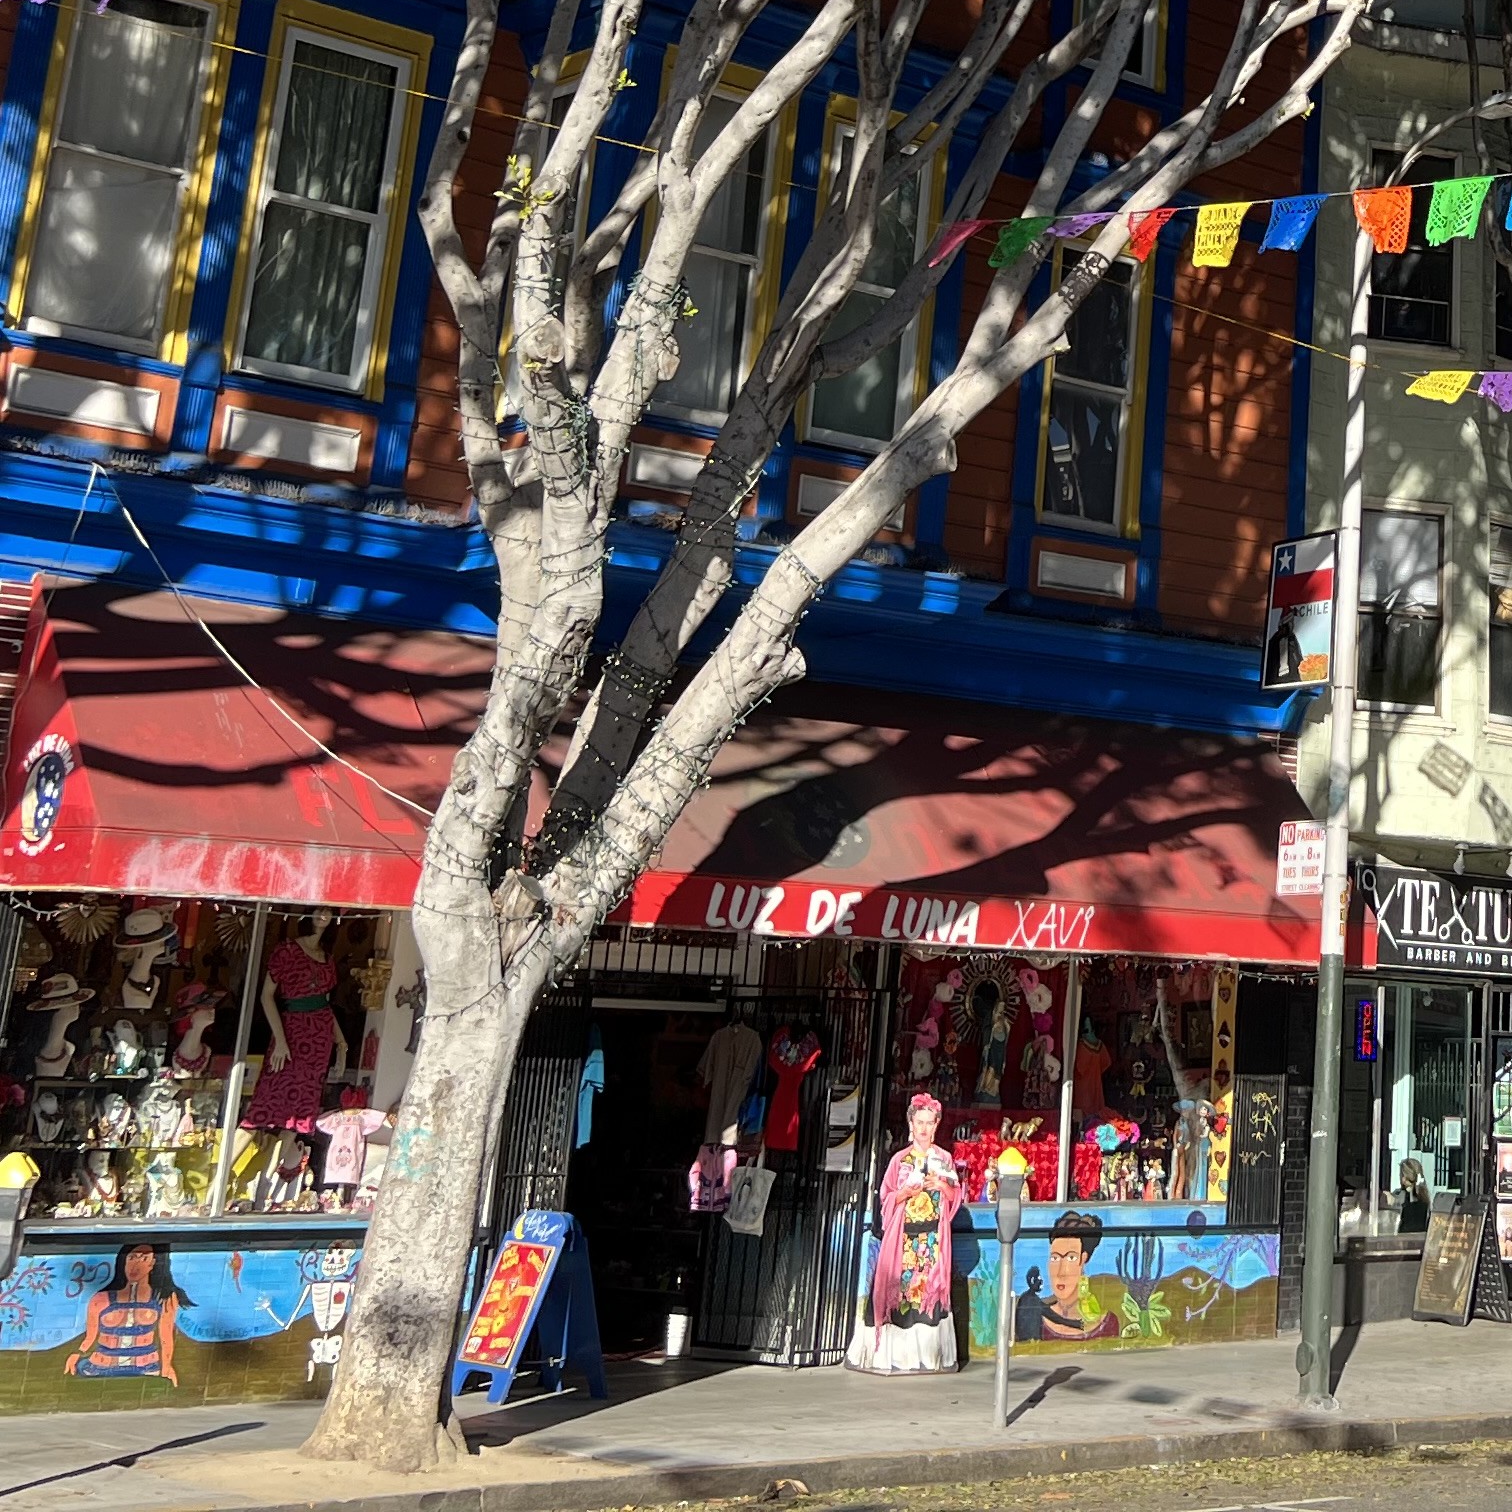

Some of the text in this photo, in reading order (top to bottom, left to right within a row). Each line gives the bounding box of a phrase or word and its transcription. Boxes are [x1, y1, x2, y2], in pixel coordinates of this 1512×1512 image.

[1299, 602, 1329, 618] CHILE
[1281, 824, 1326, 844] NO PARKING
[706, 881, 785, 935] LUZ
[805, 889, 864, 936] DE
[881, 895, 980, 945] LUNA
[1406, 947, 1456, 963] BARBER
[1465, 951, 1492, 965] AND
